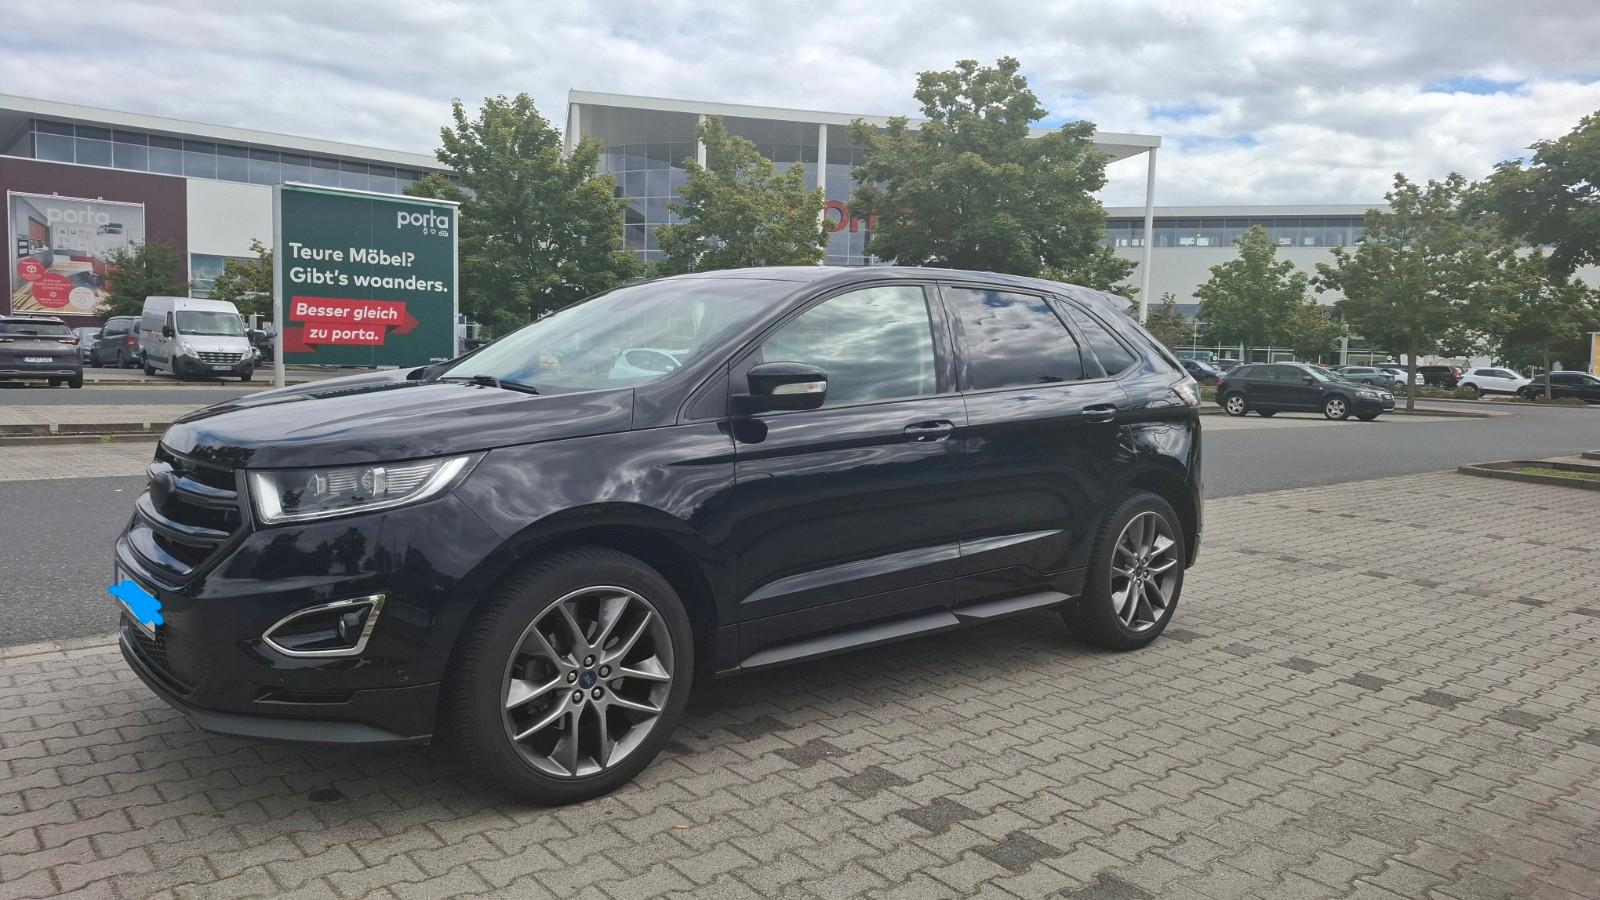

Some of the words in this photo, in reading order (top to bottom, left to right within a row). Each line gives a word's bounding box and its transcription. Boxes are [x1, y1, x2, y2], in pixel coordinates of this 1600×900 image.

[48, 206, 110, 226] porta
[397, 209, 449, 229] porta
[289, 242, 344, 261] Teure
[349, 247, 415, 267] Möbel?
[289, 267, 349, 286] Gibt's
[353, 275, 448, 292] woanders.
[296, 303, 350, 316] Besser
[353, 306, 398, 321] gleich
[309, 329, 328, 339] zu
[331, 330, 379, 341] porta.
